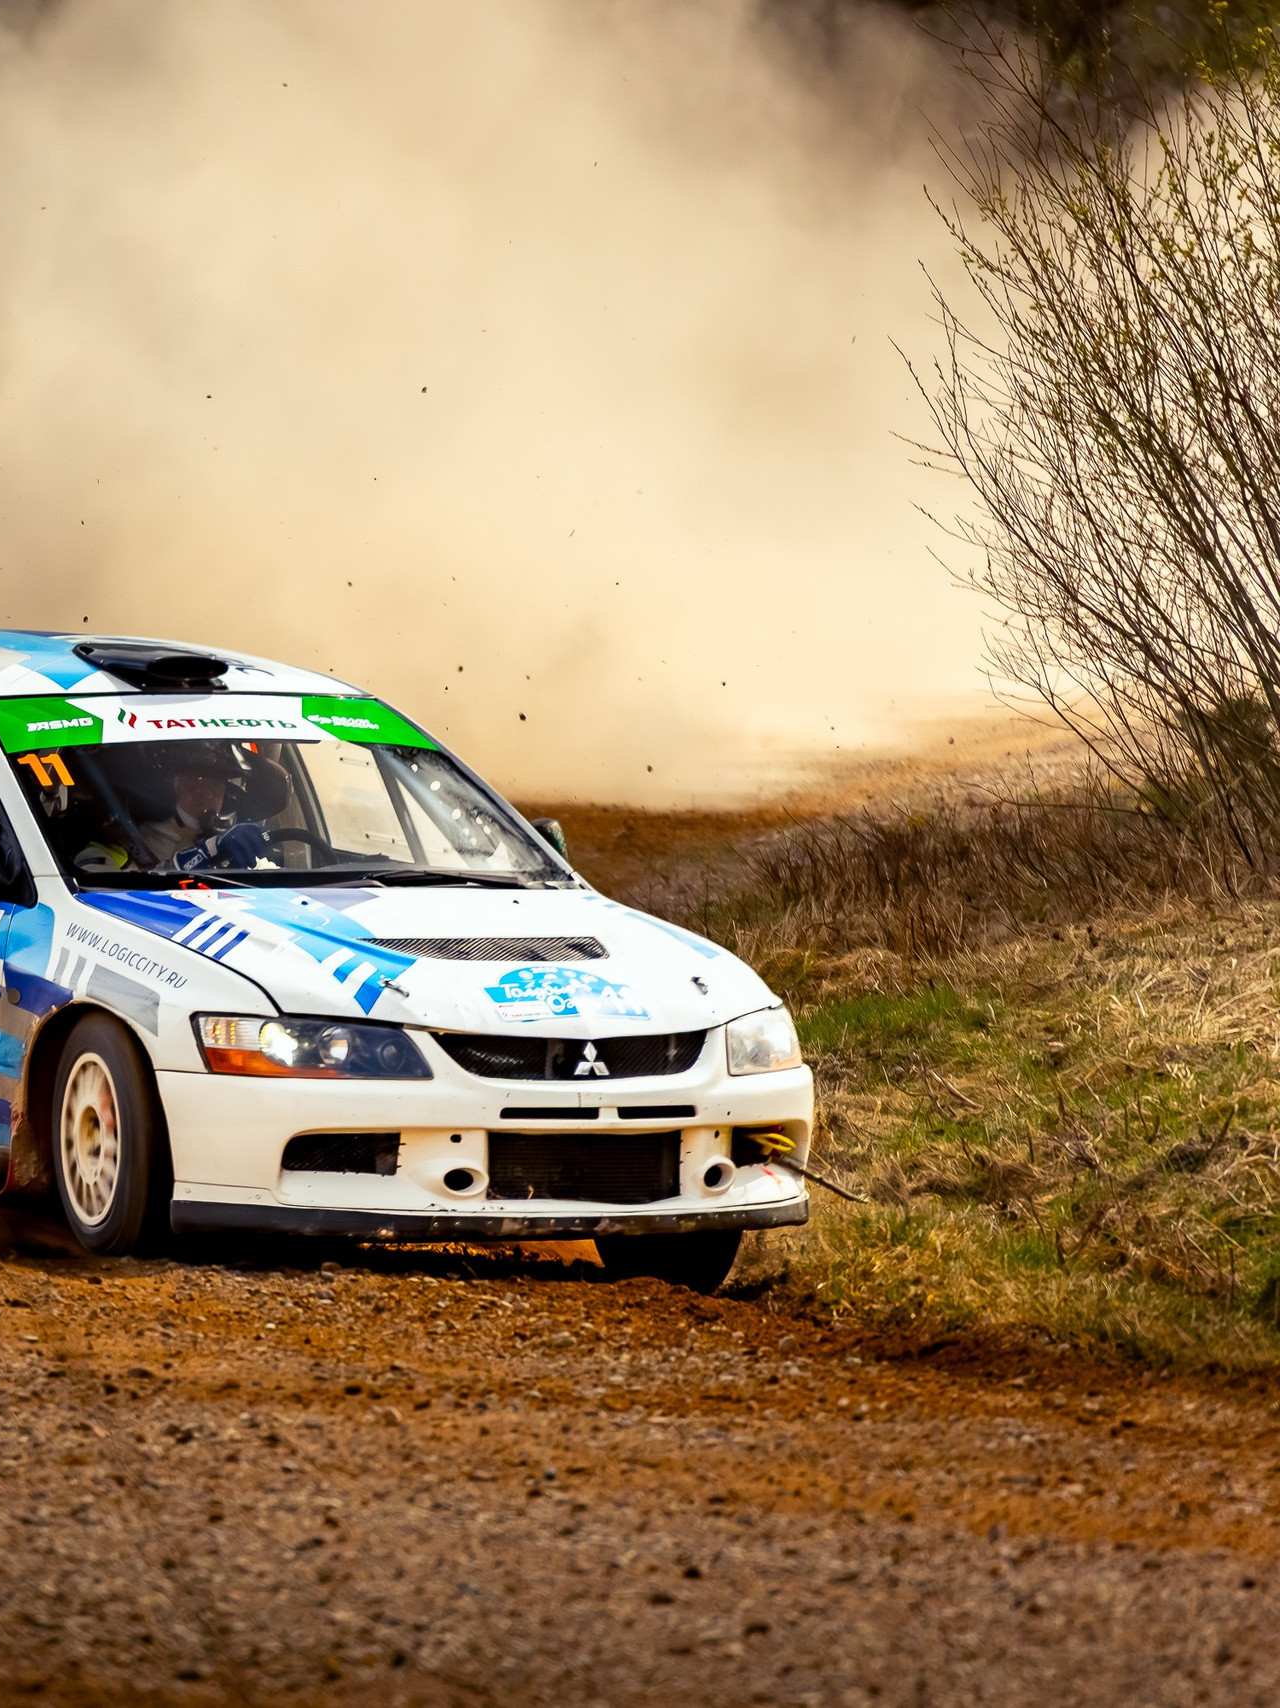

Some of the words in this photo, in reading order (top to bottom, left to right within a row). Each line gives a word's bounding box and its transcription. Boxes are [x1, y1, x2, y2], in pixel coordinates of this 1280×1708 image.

[146, 718, 297, 729] ТАТНЕФТЬ
[18, 753, 75, 787] 11
[66, 922, 188, 989] WWW.LOGICCITY.RU
